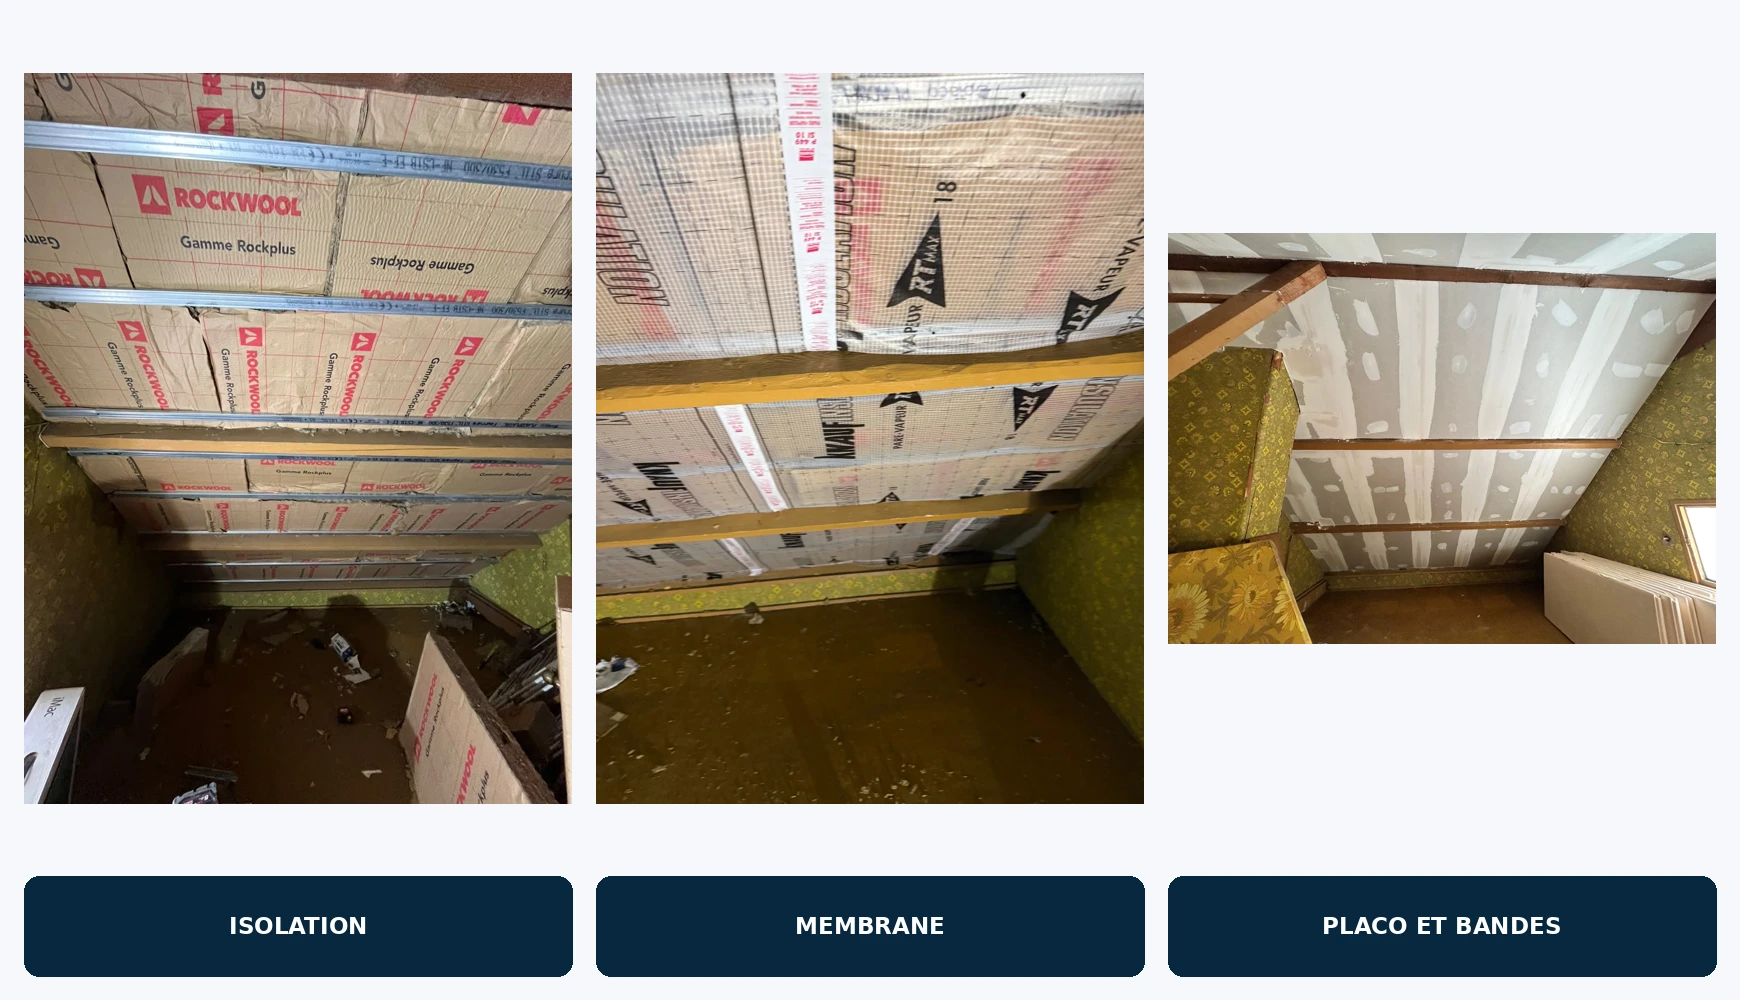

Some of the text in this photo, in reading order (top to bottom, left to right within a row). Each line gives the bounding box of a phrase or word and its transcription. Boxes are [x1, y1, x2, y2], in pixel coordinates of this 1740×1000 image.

[174, 187, 302, 217] ROCKWOOL
[933, 181, 957, 203] 18
[180, 236, 296, 257] Gamme Rockplus
[370, 256, 475, 274] Gamme Rockplus
[107, 341, 144, 408] Gamme Rockplus
[134, 345, 170, 411] ROCKWOOL
[220, 348, 231, 380] Gamme
[326, 352, 338, 384] Gamme
[420, 357, 440, 388] Gamme
[542, 363, 572, 391] Gamme
[246, 349, 261, 415] ROCKWOOL
[340, 354, 365, 416] ROCKWOOL
[423, 359, 466, 418] ROCKWOOL
[813, 422, 865, 459] KNAUF
[44, 696, 65, 718] iMac
